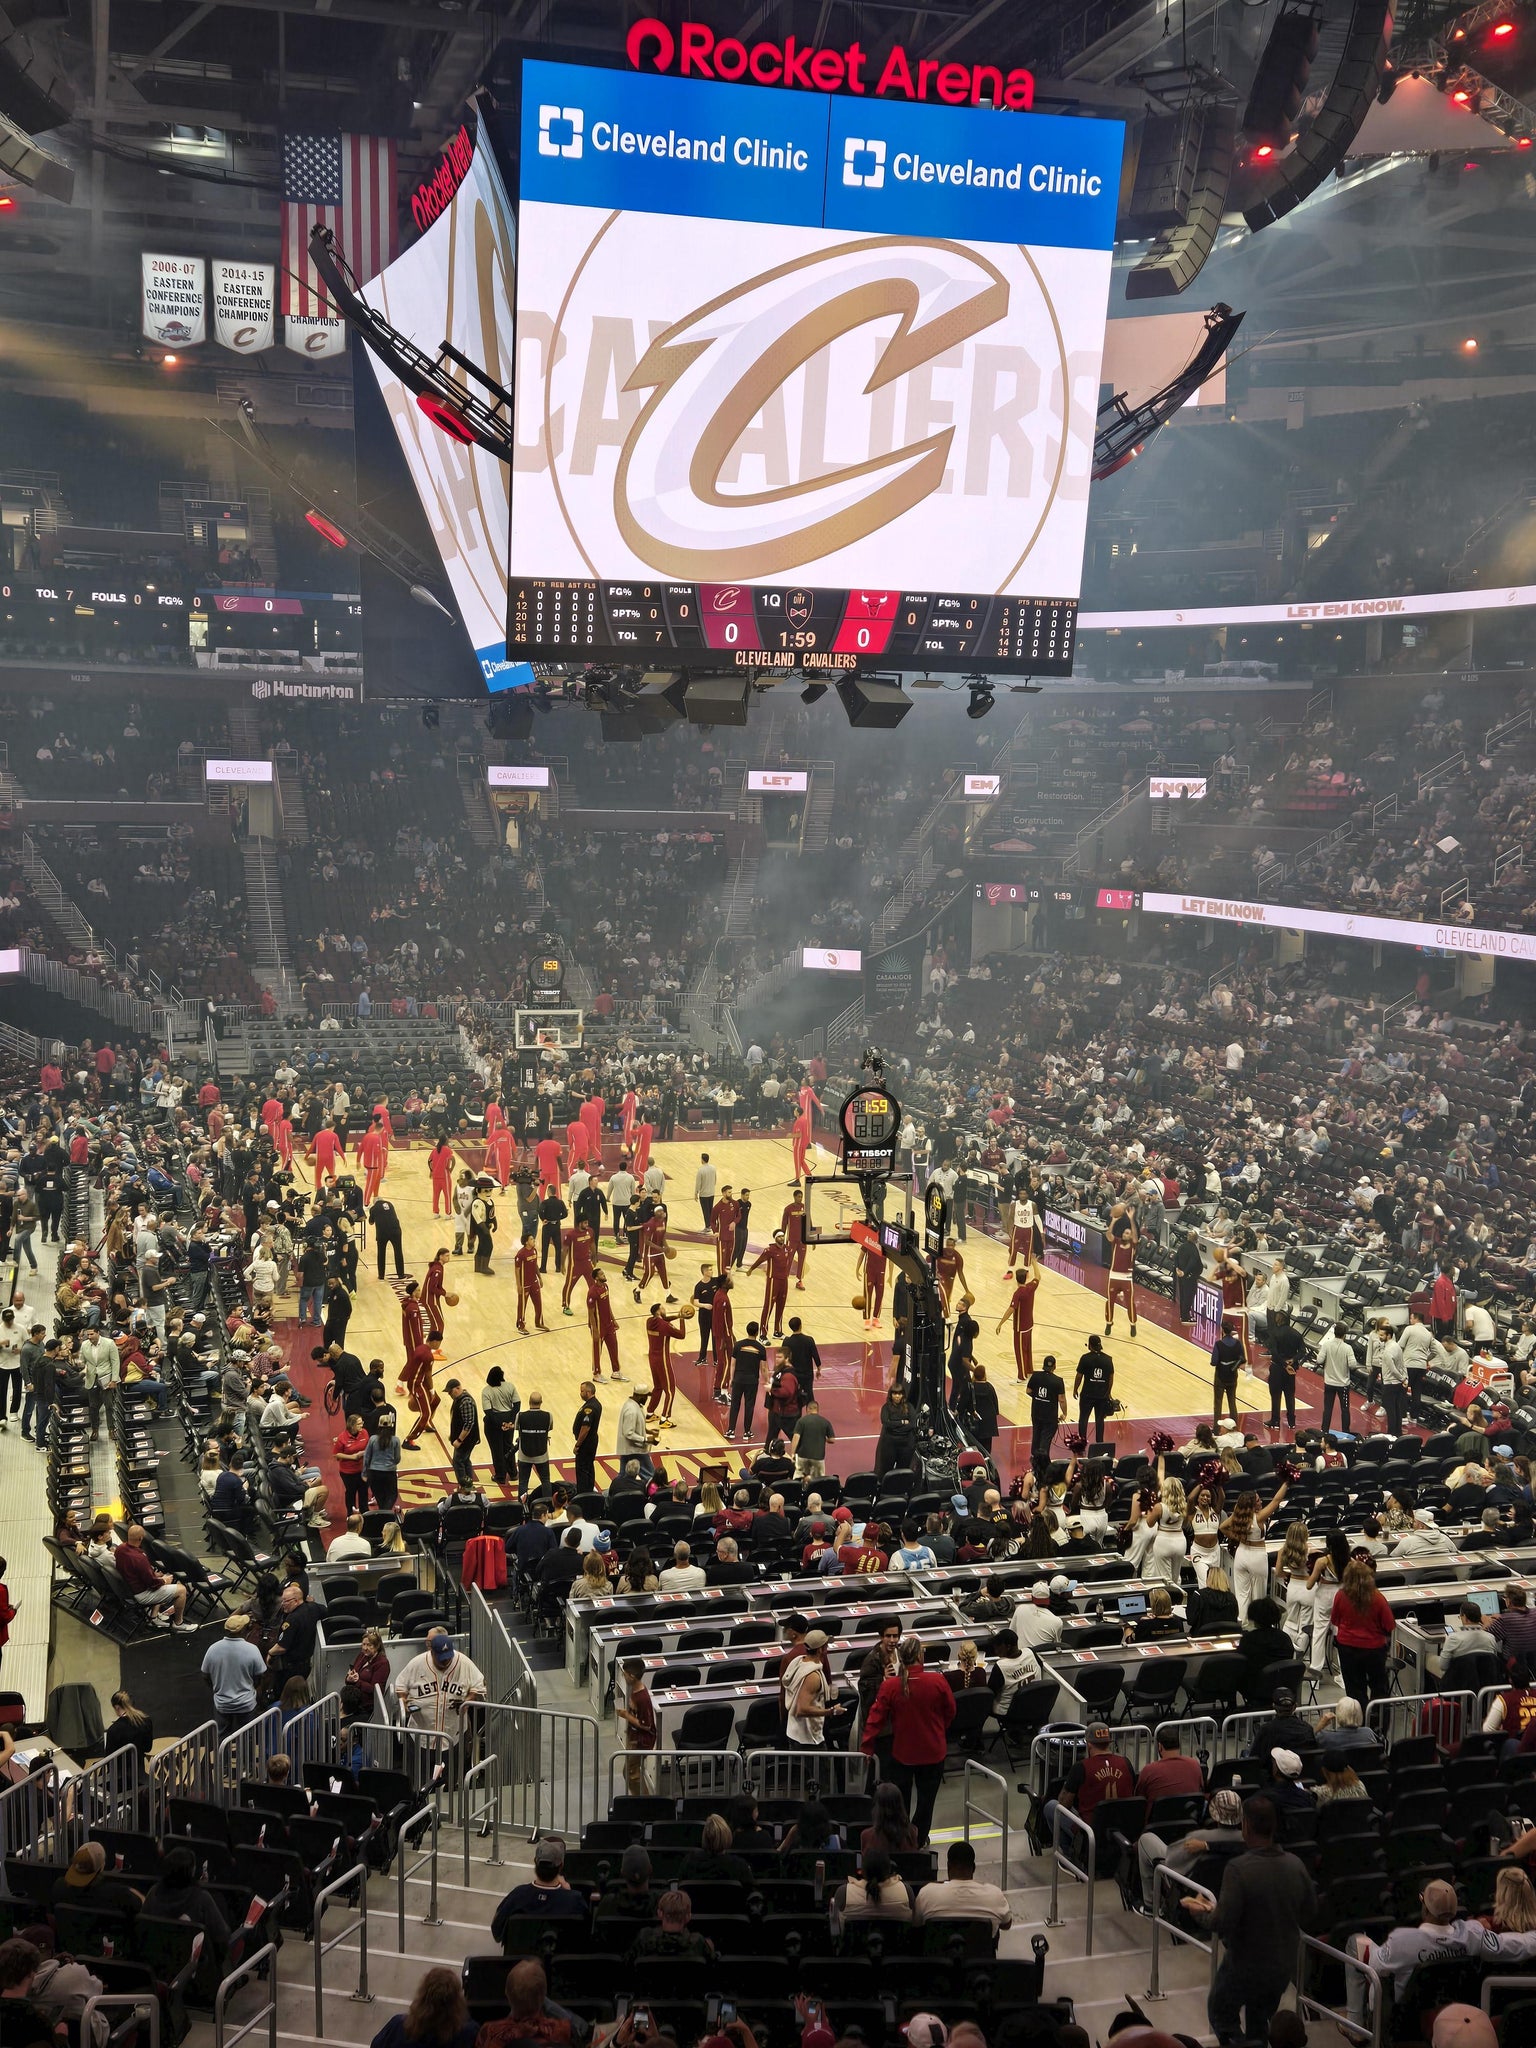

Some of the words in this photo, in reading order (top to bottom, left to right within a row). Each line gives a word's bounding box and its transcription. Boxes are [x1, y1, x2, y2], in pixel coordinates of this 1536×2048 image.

[680, 21, 867, 95] Rocket
[875, 45, 1034, 111] Arena
[590, 121, 727, 165] Cleveland
[733, 135, 809, 172] Clinic
[892, 151, 1022, 191] Cleveland
[1028, 164, 1102, 198] Clinic
[151, 261, 196, 276] 2006-07
[221, 268, 265, 282] 2014-15
[153, 276, 194, 291] EASTERN
[223, 282, 263, 297] EASTERN
[146, 290, 203, 305] CONFERENCE
[216, 295, 271, 310] CONFERENCE
[148, 303, 201, 318] CHAMPIONS
[218, 309, 269, 323] CHAMPIONS
[290, 315, 340, 327] CHAMPIONS
[2, 586, 11, 598] 0
[36, 589, 58, 599] TOL
[66, 590, 74, 601] 7
[92, 592, 126, 603] FOULS
[133, 594, 142, 606] 0
[158, 596, 183, 606] FG%
[193, 597, 201, 608] 0
[518, 590, 525, 599] 4
[537, 591, 543, 600] 0
[555, 591, 561, 600] 0
[572, 591, 579, 601] 0
[588, 592, 594, 601] 0
[609, 587, 632, 597] FG%
[643, 587, 651, 597] 0
[264, 600, 273, 611] 0
[516, 601, 528, 610] 12
[537, 601, 543, 611] 0
[554, 602, 561, 611] 0
[572, 602, 578, 612] 0
[587, 603, 594, 612] 0
[762, 594, 781, 607] 1Q
[938, 599, 961, 609] FG%
[970, 599, 978, 609] 0
[612, 609, 641, 619] 3PT%
[650, 608, 657, 619] 0
[679, 604, 689, 618] 0
[1003, 607, 1009, 616] 3
[1019, 608, 1025, 617] 0
[1035, 609, 1042, 618] 0
[1052, 609, 1058, 618] 0
[1066, 610, 1072, 618] 0
[1287, 605, 1322, 618] LET
[1323, 603, 1350, 615] EM
[1351, 600, 1405, 614] KNOW.
[515, 612, 527, 621] 20
[536, 612, 543, 621] 0
[554, 612, 560, 622] 0
[571, 613, 578, 622] 0
[587, 613, 594, 623] 0
[907, 612, 916, 625] 0
[1002, 618, 1008, 626] 9
[1018, 618, 1024, 627] 0
[1035, 619, 1041, 628] 0
[1051, 619, 1057, 628] 0
[1065, 620, 1071, 629] 0
[515, 623, 527, 632] 31
[536, 623, 542, 632] 0
[553, 623, 560, 633] 0
[571, 623, 577, 633] 0
[587, 624, 593, 633] 0
[932, 619, 960, 628] 3PT%
[965, 619, 973, 630] 0
[514, 633, 527, 642] 45
[617, 631, 638, 640] TOL
[655, 631, 663, 642] 7
[724, 623, 738, 643] 0
[780, 631, 816, 647] 1:59
[857, 628, 870, 648] 0
[999, 628, 1010, 637] 13
[1017, 629, 1024, 637] 0
[1034, 629, 1040, 638] 0
[1050, 630, 1056, 638] 0
[1064, 630, 1070, 639] 0
[925, 640, 944, 649] TOL
[959, 641, 966, 651] 7
[998, 638, 1010, 646] 14
[1016, 639, 1023, 647] 0
[1033, 639, 1039, 648] 0
[1049, 639, 1055, 648] 0
[1063, 640, 1069, 648] 0
[997, 648, 1009, 656] 35
[735, 650, 795, 667] CLEVELAND
[803, 653, 857, 668] CAVALIERS
[273, 680, 354, 700] Huntington
[762, 775, 793, 786] LET
[970, 780, 994, 790] EM
[1151, 781, 1205, 794] KNOW.
[1010, 888, 1016, 898] 0
[1030, 890, 1039, 898] 1Q
[1053, 892, 1071, 900] 1:59
[1106, 892, 1112, 904] 0
[1181, 898, 1205, 913] LET
[1207, 901, 1225, 916] EM
[1225, 903, 1266, 921] KNOW.
[1436, 929, 1507, 952] CLEVELAND
[543, 960, 558, 970] 1:59
[865, 1099, 889, 1113] 1:59
[860, 1149, 893, 1157] TISSOT
[1080, 1226, 1086, 1245] 21
[1477, 1367, 1484, 1378] G
[858, 1554, 881, 1573] 10
[417, 1680, 463, 1697] ASTROS
[1094, 1765, 1123, 1781] MOBLEY
